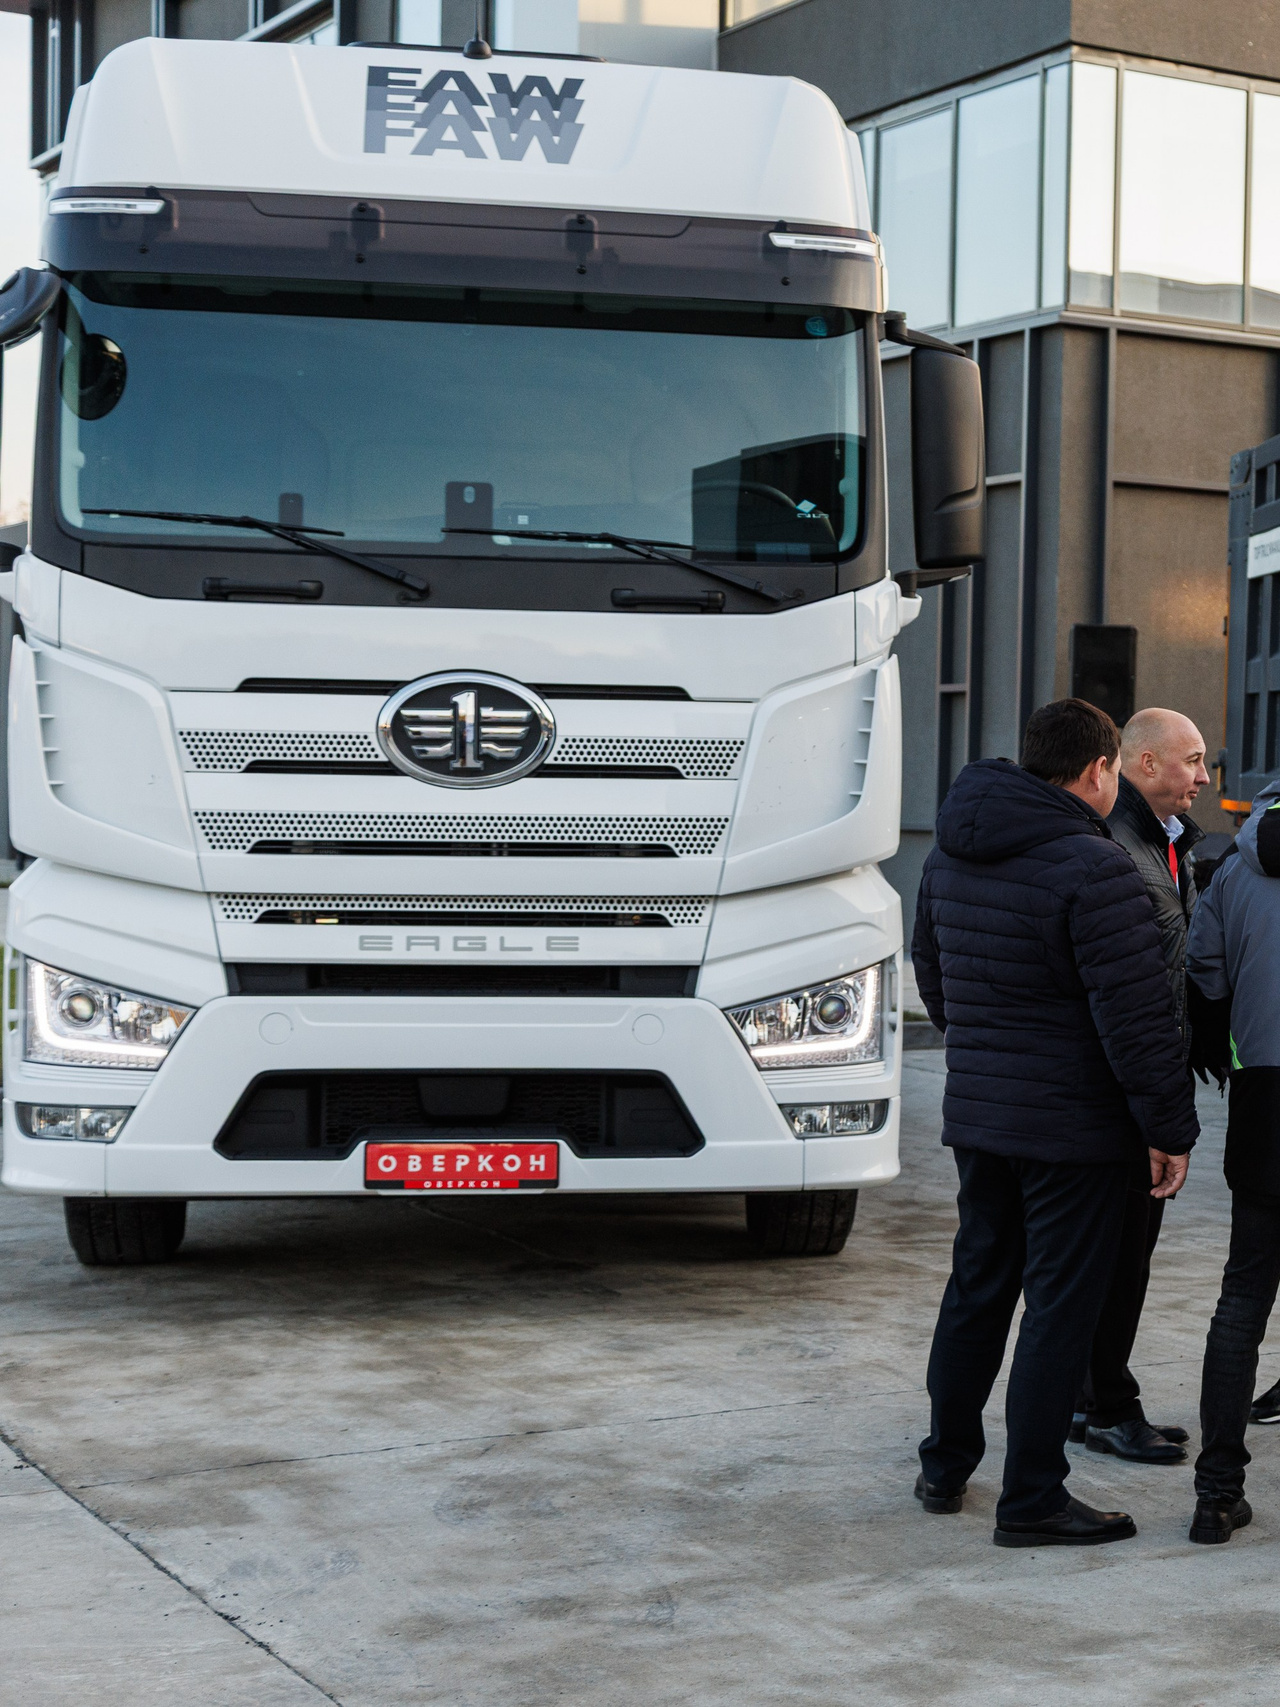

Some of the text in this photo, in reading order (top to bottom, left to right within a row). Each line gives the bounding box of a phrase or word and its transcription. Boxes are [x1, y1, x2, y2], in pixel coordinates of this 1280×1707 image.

[363, 109, 585, 165] FAW
[358, 935, 580, 952] EAGLE
[377, 1154, 546, 1173] ОВЕРКОН
[423, 1180, 501, 1189] ОВЕРКОН
